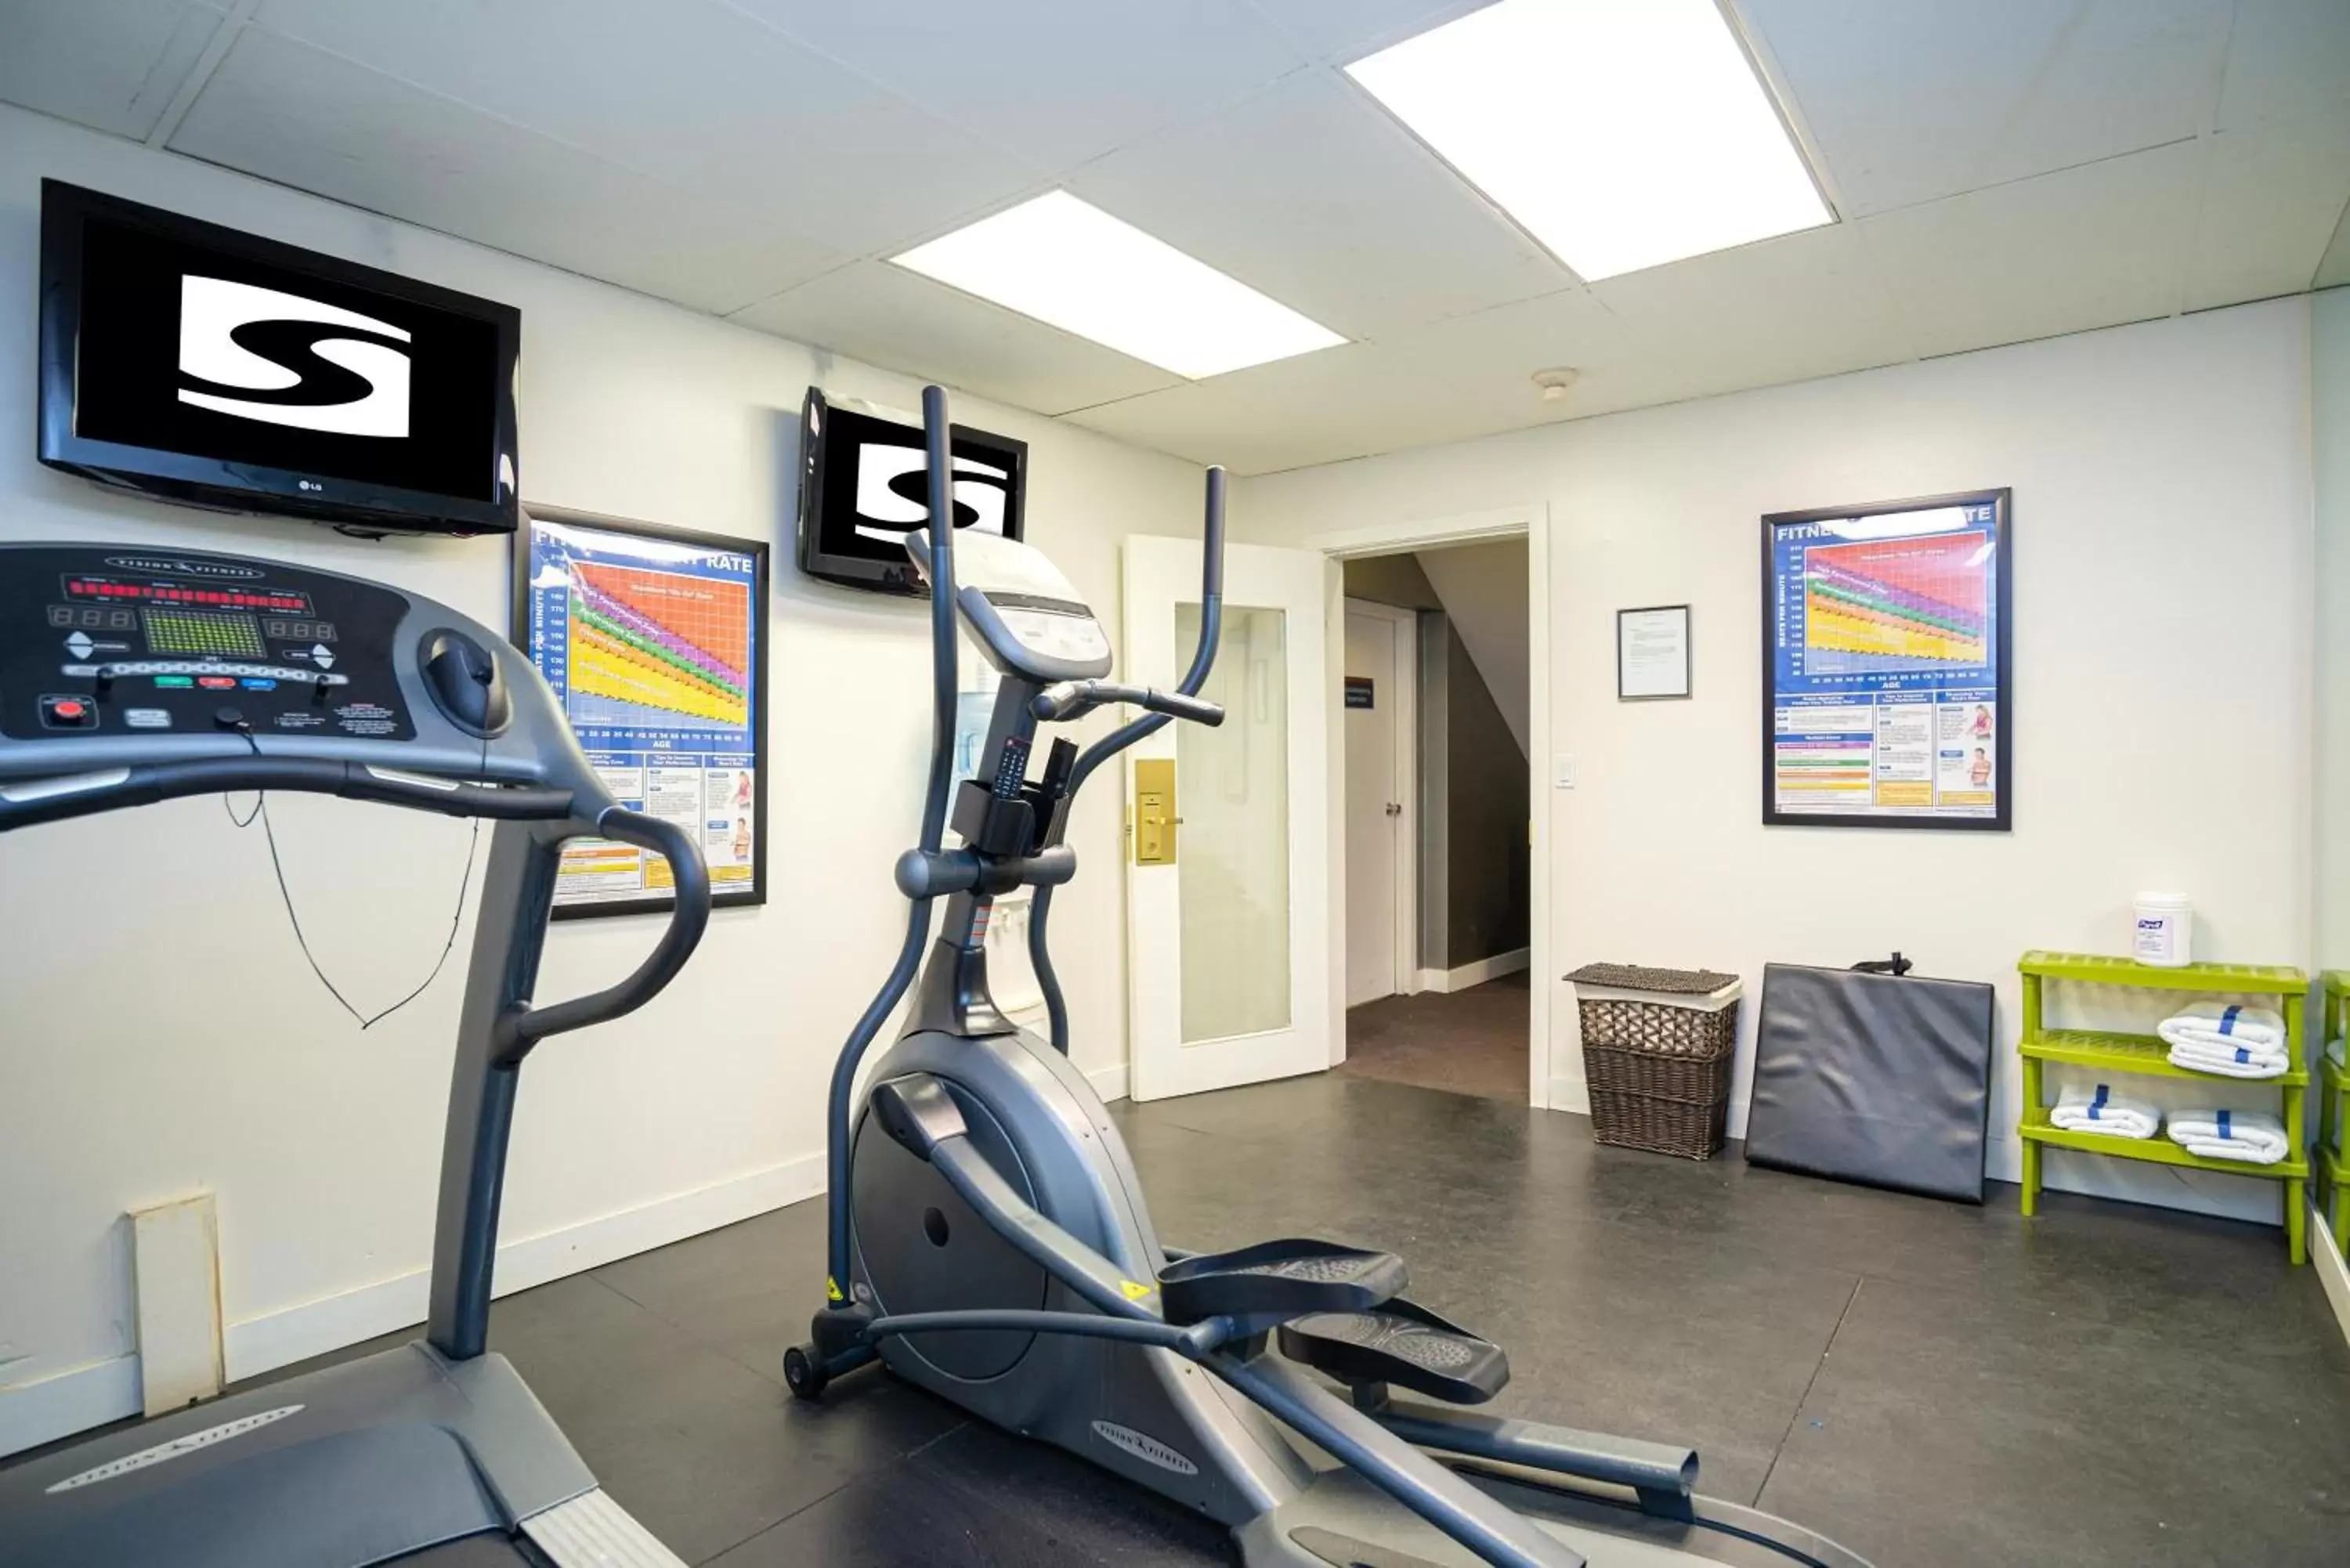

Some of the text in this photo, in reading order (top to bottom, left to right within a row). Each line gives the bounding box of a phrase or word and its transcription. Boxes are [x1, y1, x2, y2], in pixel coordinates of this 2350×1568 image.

[1777, 526, 1834, 541] FITNE
[706, 555, 752, 574] RATE
[1100, 1423, 1189, 1470] VISION FITNESS
